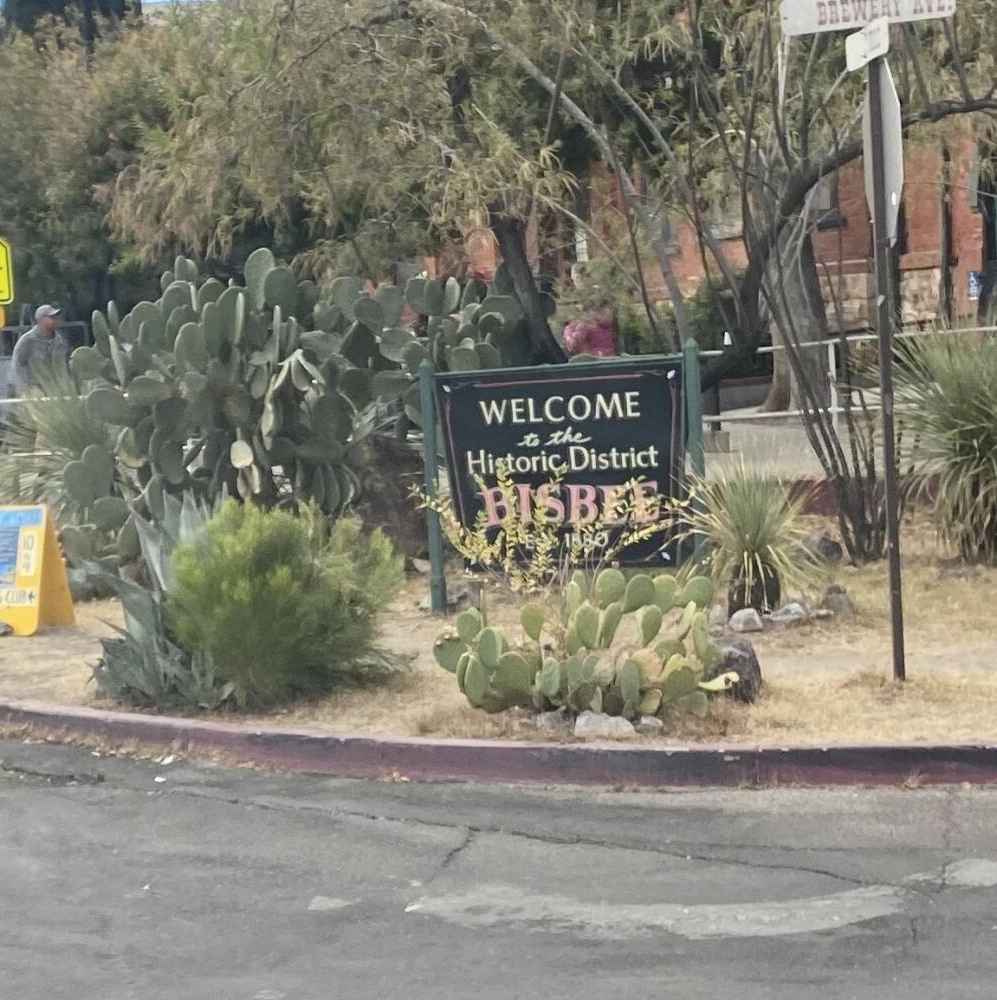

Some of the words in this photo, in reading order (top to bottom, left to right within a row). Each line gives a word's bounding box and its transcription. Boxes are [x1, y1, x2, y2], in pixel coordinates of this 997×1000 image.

[479, 391, 641, 425] WELCOME
[517, 431, 540, 447] to
[544, 426, 592, 447] the
[467, 449, 564, 475] Historic
[569, 445, 659, 471] District
